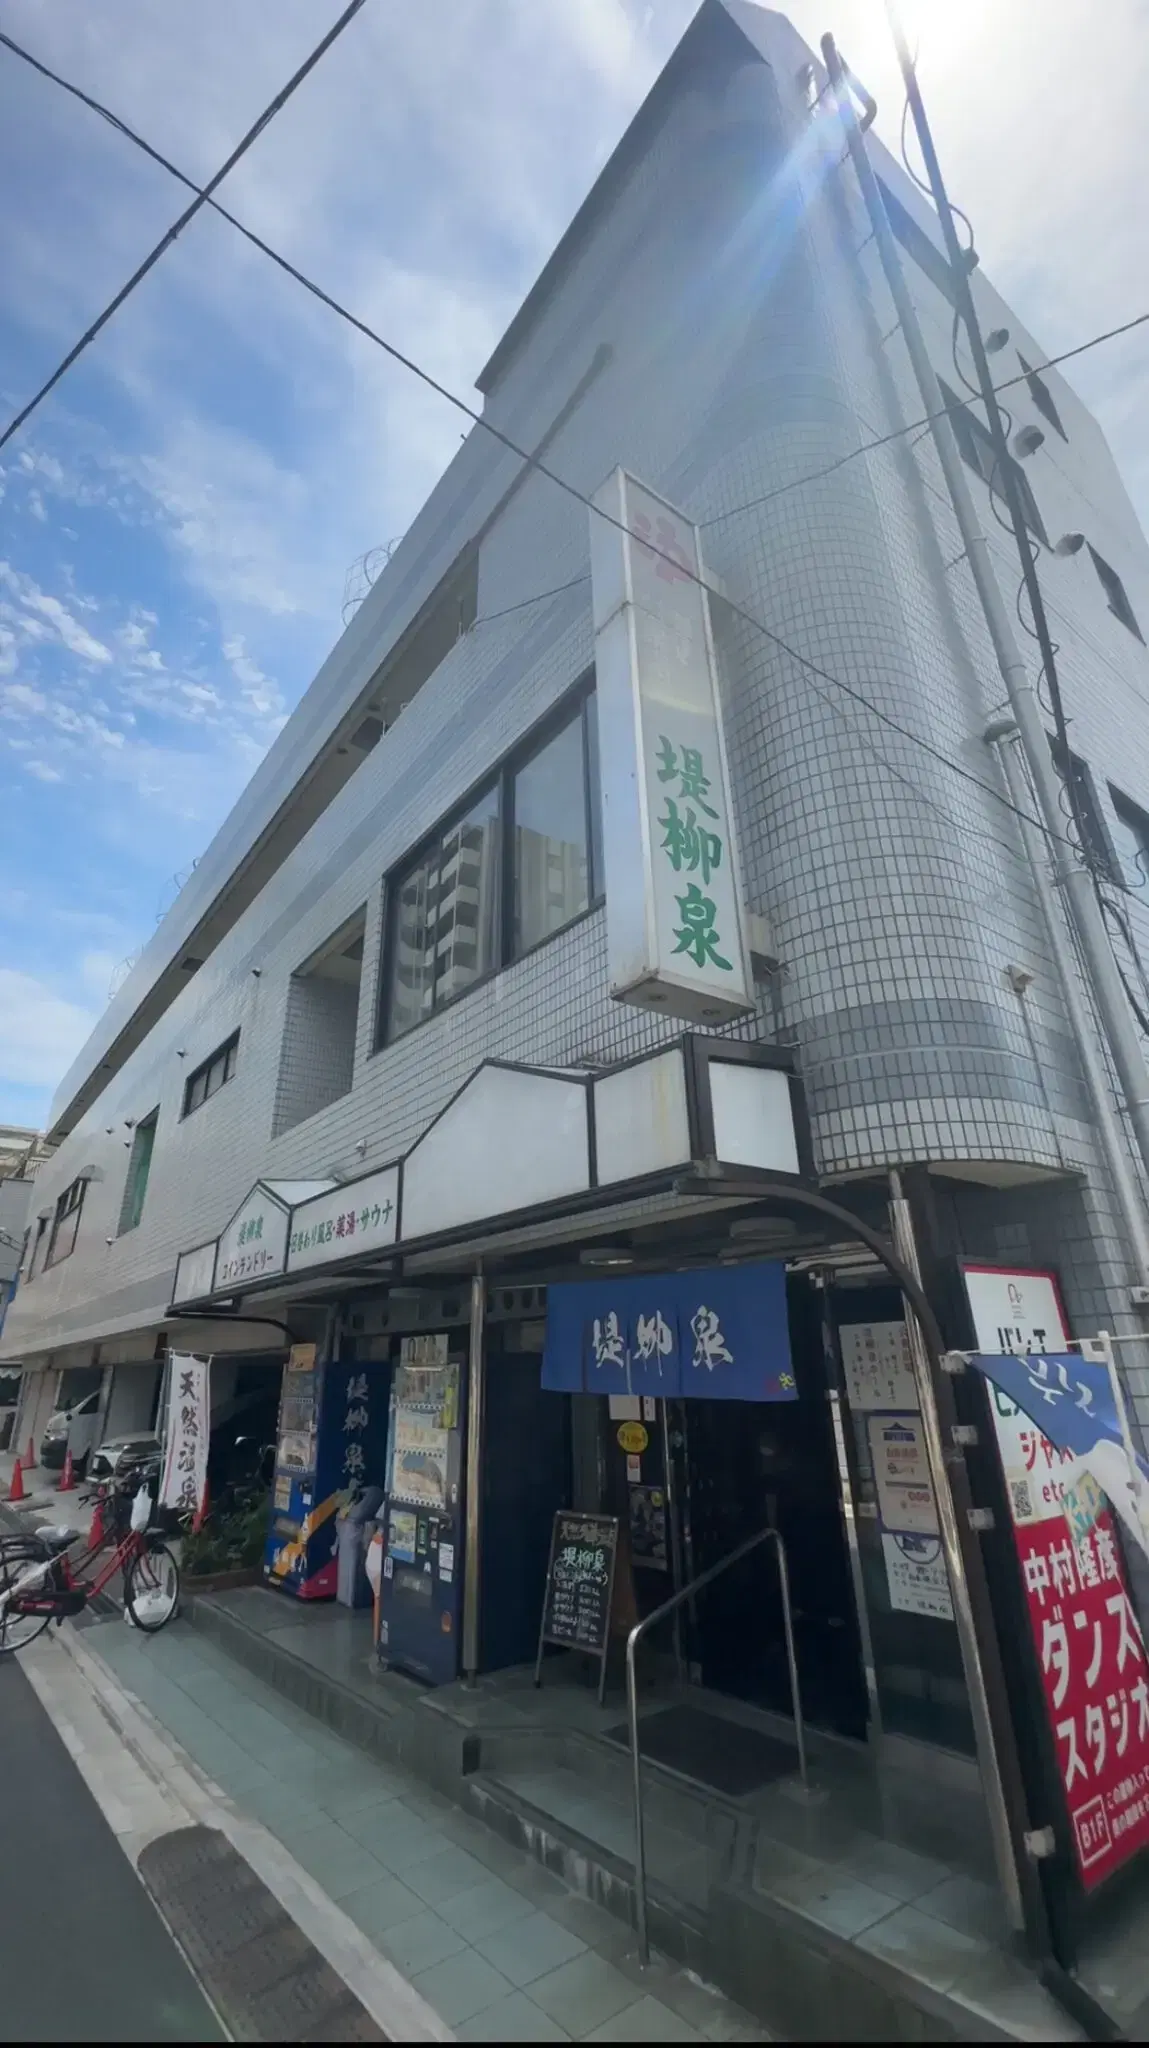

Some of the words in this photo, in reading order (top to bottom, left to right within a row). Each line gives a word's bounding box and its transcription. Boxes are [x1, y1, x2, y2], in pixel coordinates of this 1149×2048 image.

[654, 733, 734, 972] 堤柳泉
[221, 1248, 274, 1280] コインランドリー
[592, 1305, 734, 1377] 堤柳泉
[176, 1370, 199, 1509] 天然温泉
[1041, 1593, 1142, 1710] ダンス
[1080, 1811, 1104, 1849] B1F
